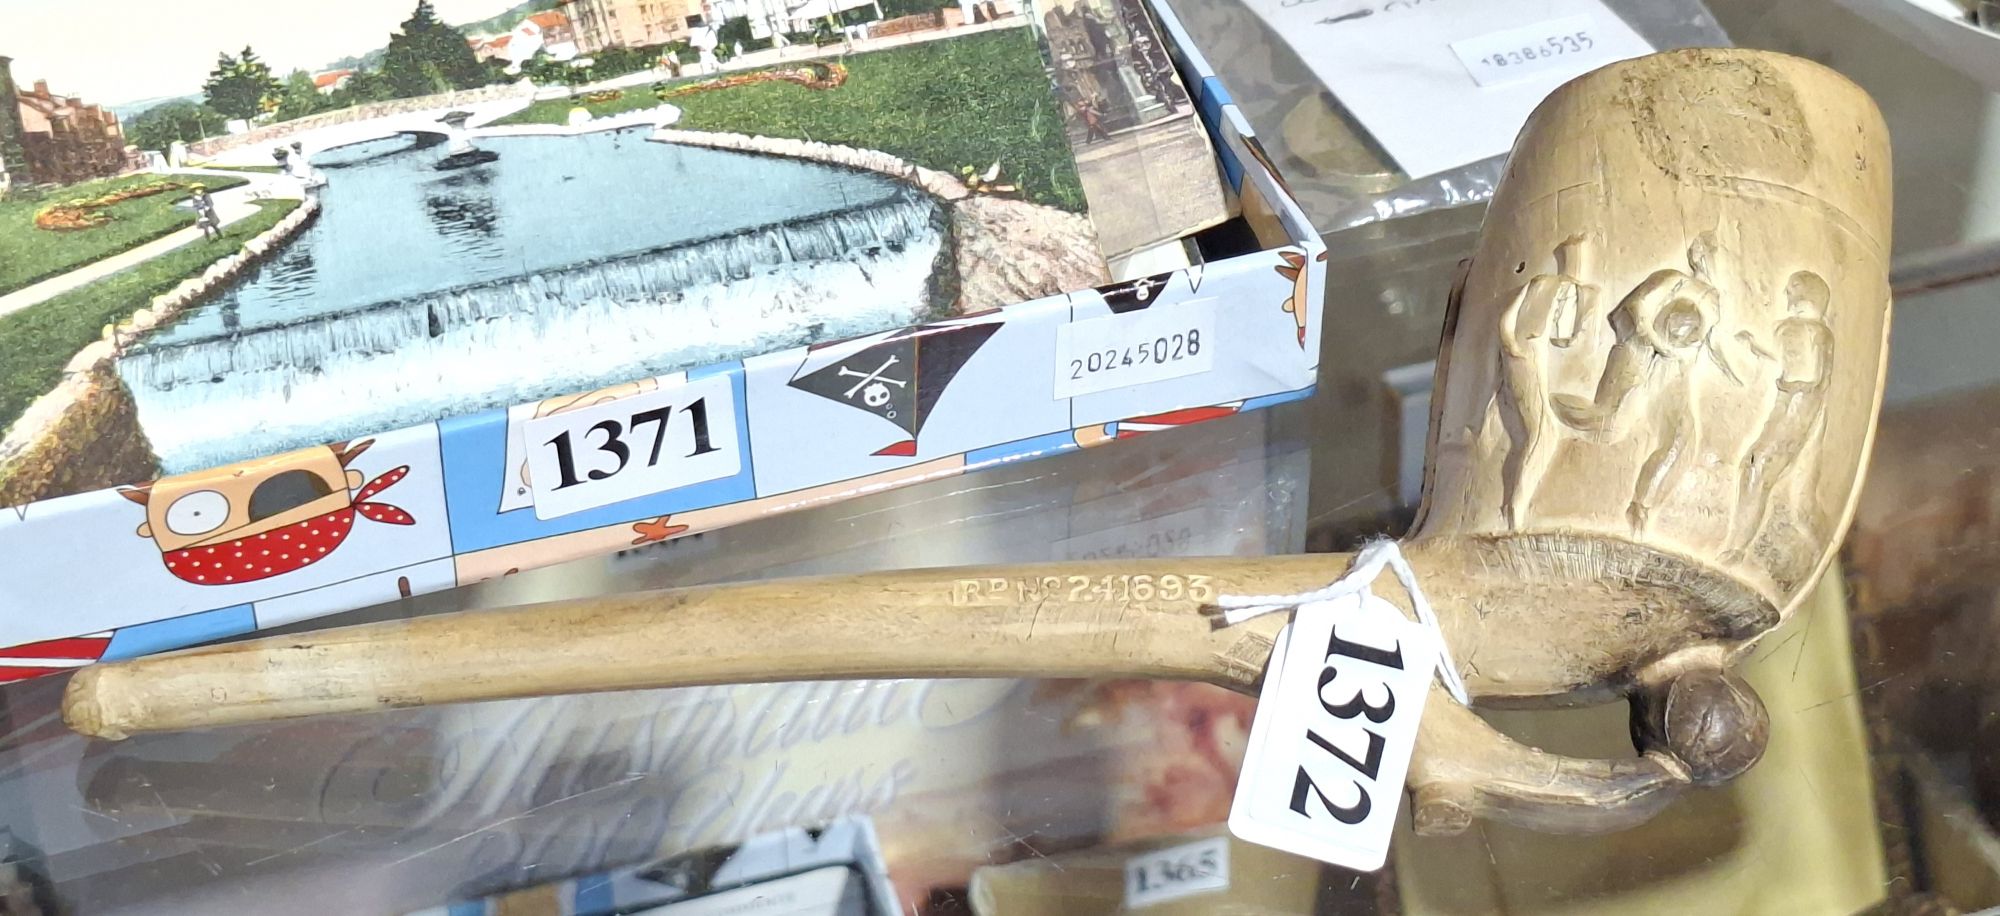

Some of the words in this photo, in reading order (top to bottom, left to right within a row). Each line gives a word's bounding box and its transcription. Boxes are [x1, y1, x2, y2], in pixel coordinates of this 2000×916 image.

[1070, 328, 1201, 380] 20245028
[543, 396, 723, 493] 1371
[1066, 574, 1215, 602] 241693
[1289, 623, 1405, 826] 1372
